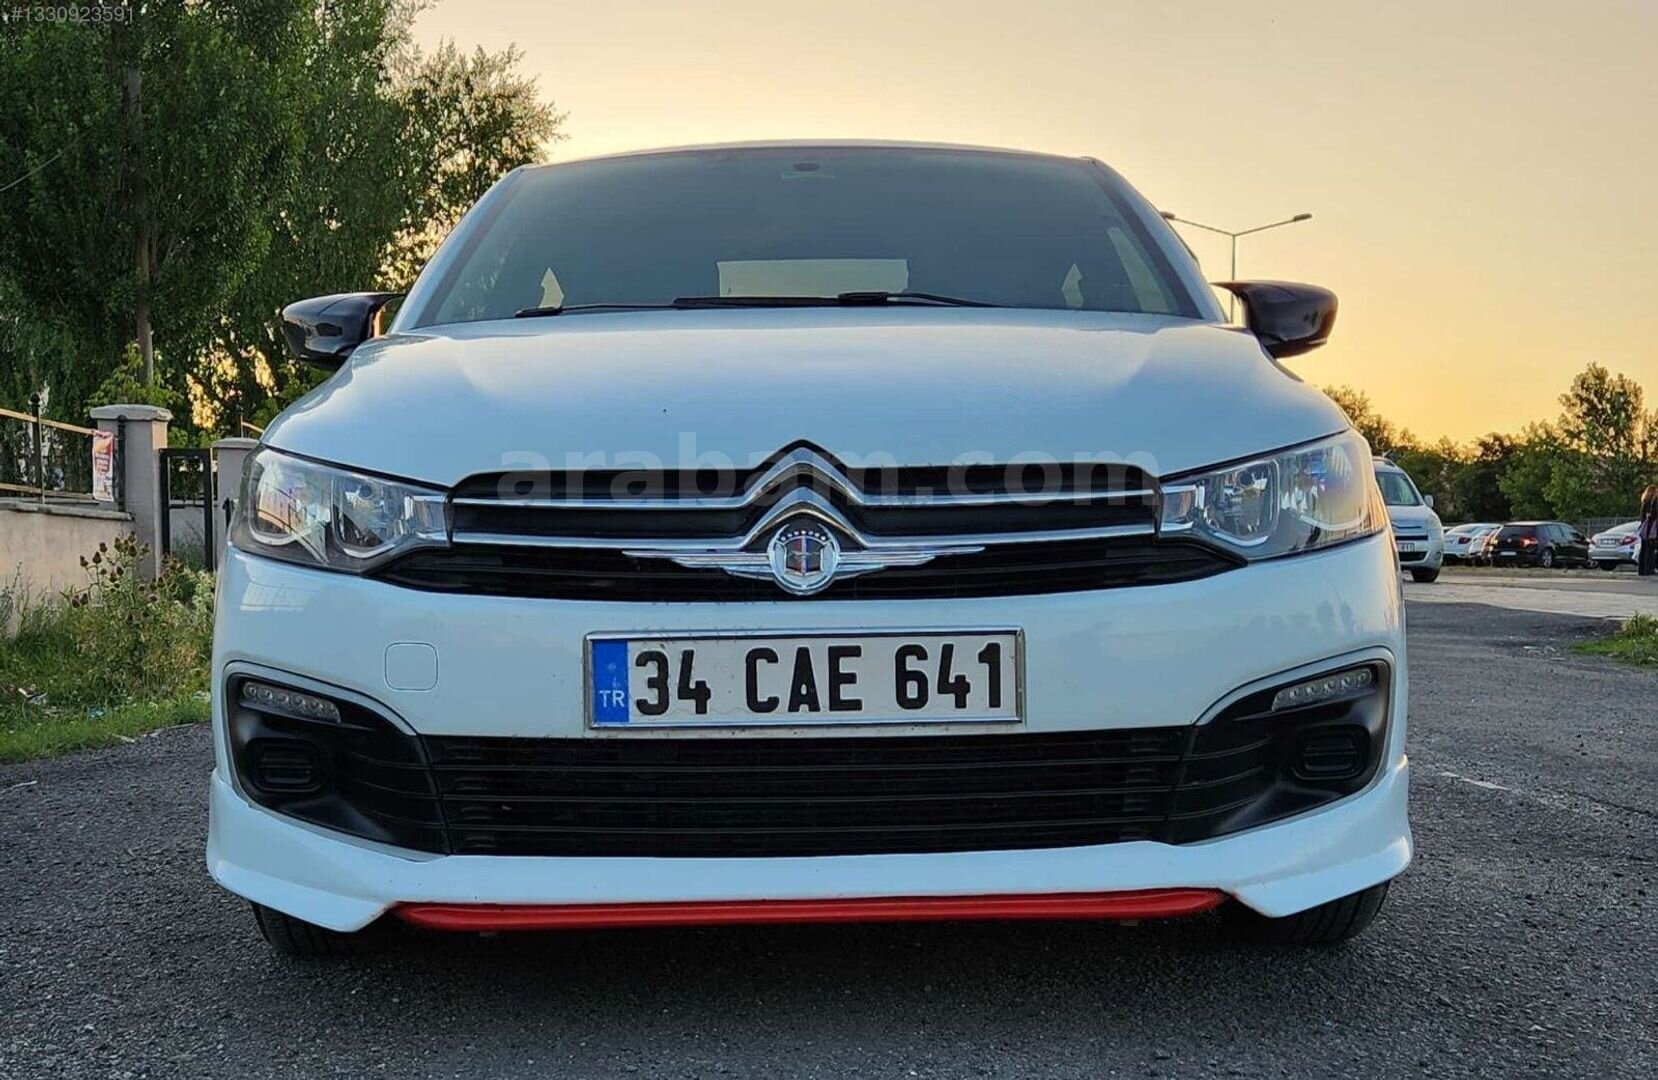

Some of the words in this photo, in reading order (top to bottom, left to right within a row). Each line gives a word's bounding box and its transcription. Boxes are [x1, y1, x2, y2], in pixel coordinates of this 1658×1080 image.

[599, 690, 625, 708] TR
[635, 649, 711, 715] 34
[745, 645, 863, 713] CAE
[895, 642, 1001, 710] 641
